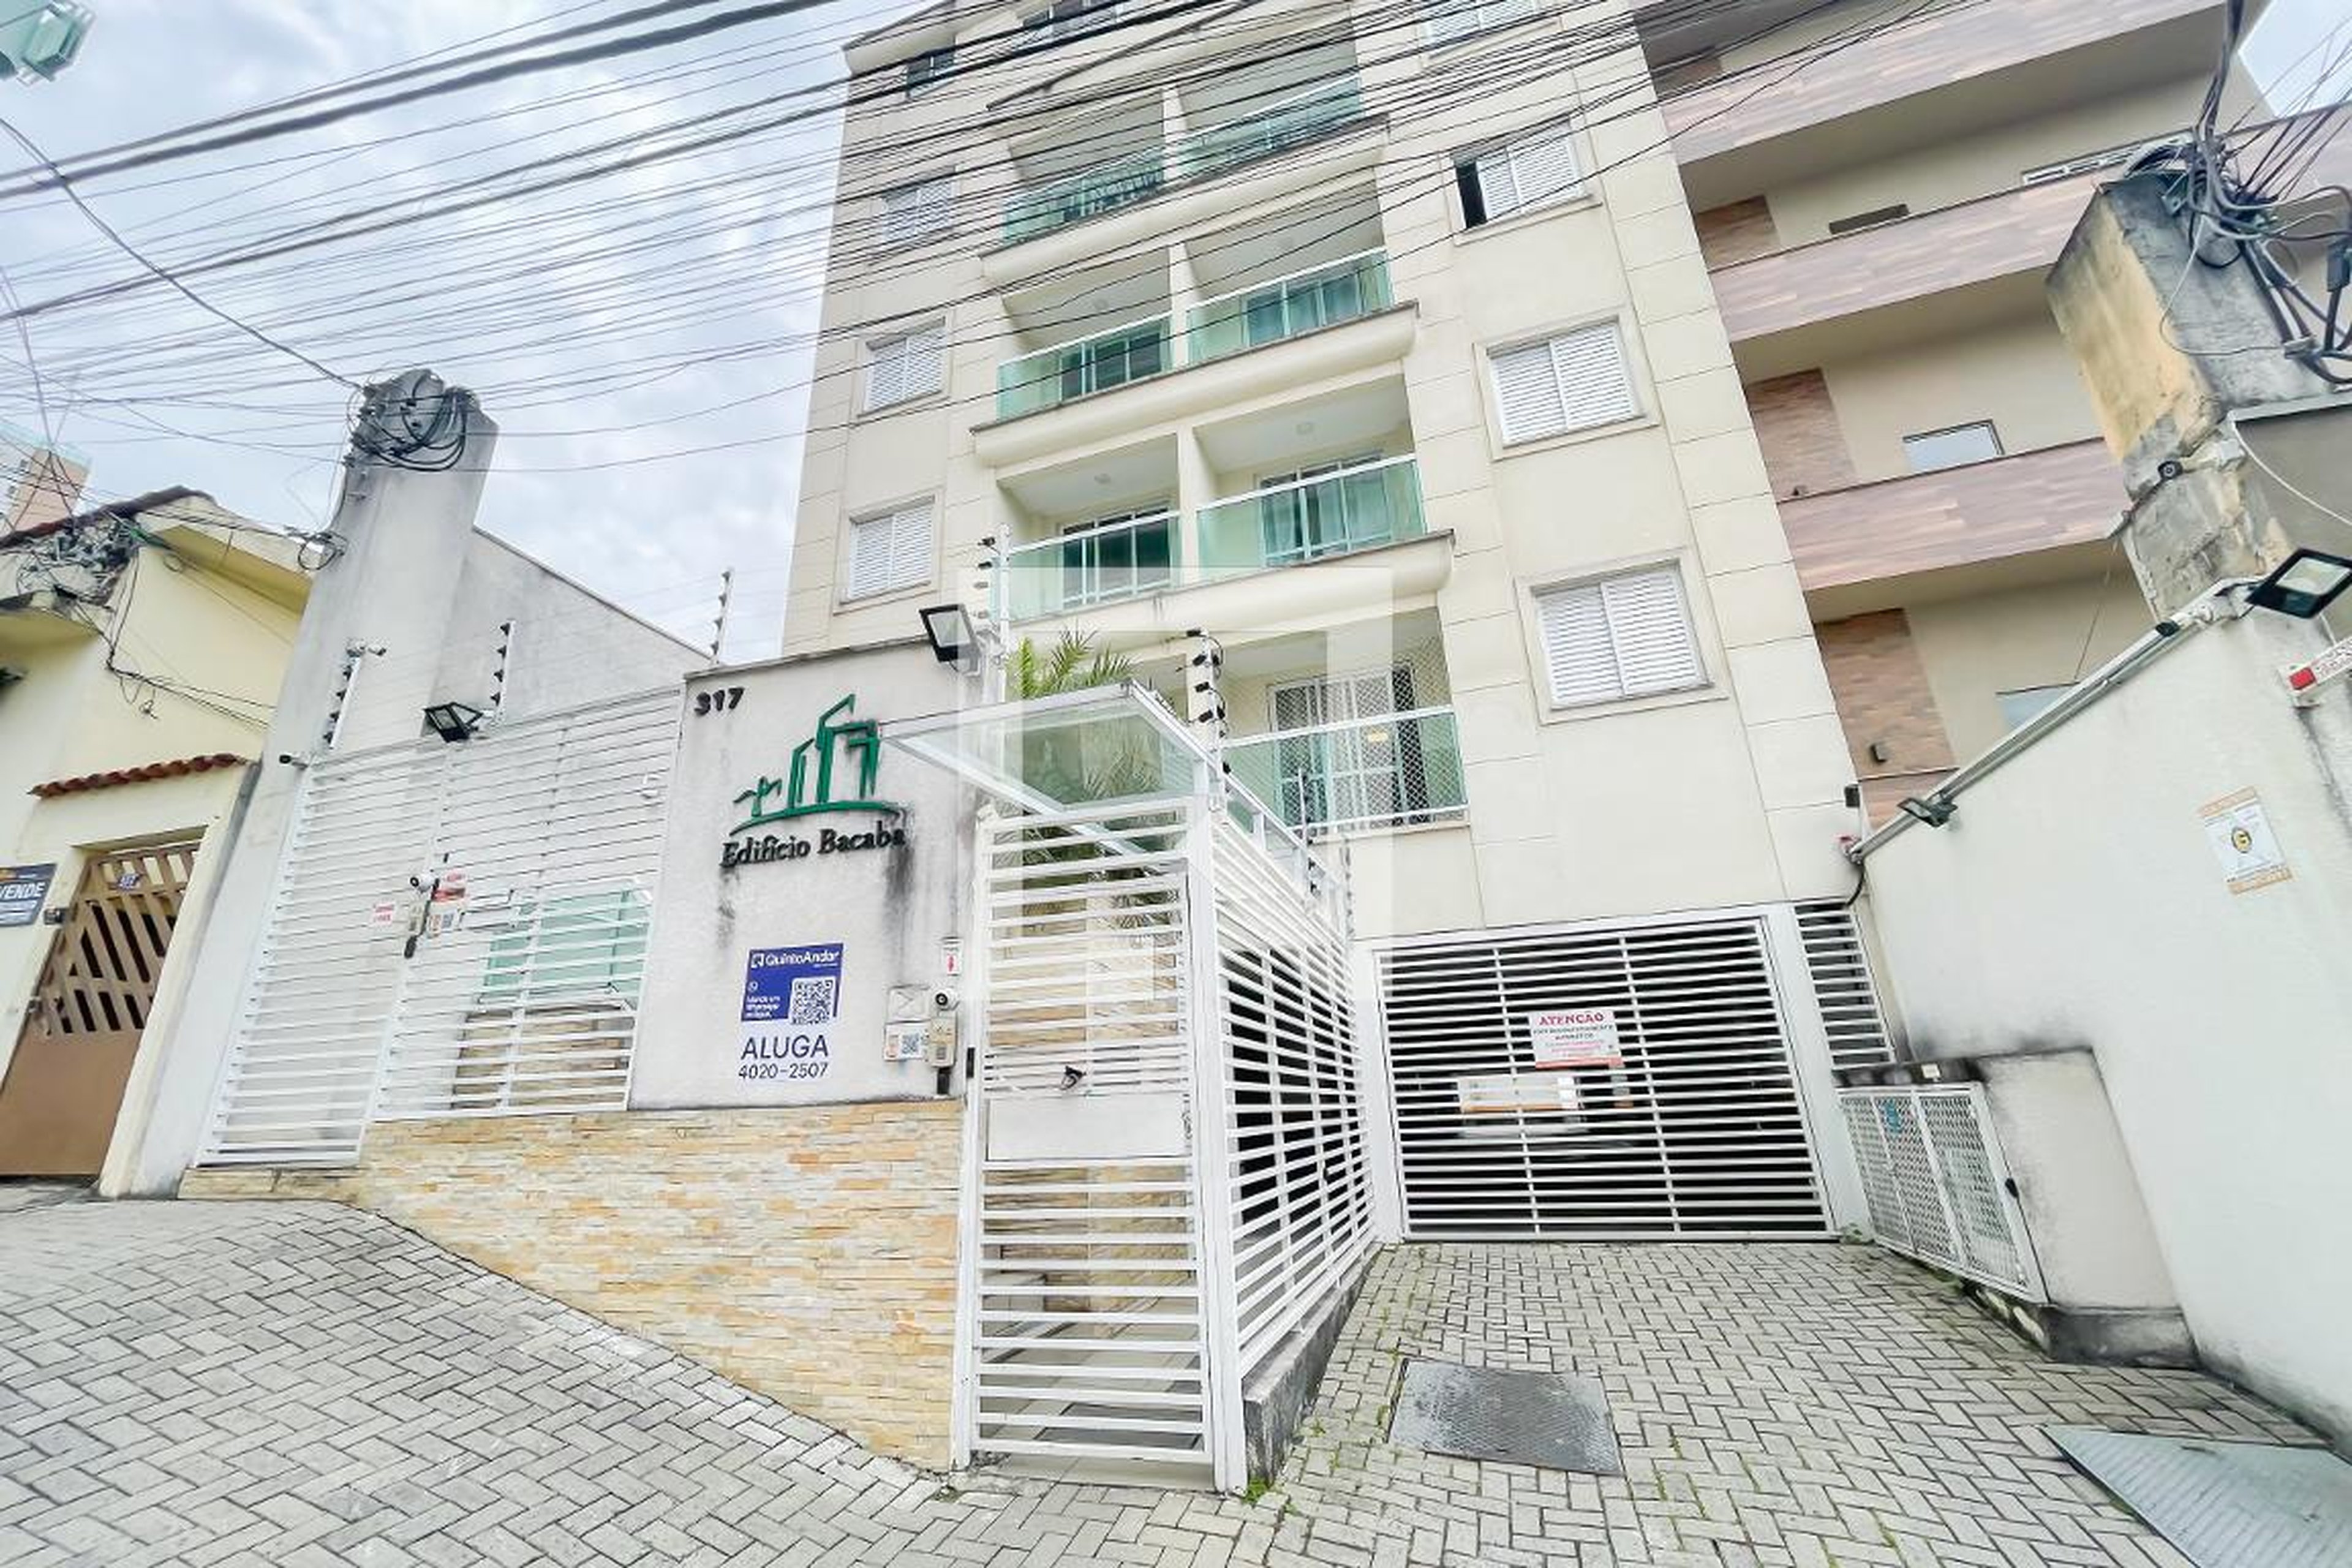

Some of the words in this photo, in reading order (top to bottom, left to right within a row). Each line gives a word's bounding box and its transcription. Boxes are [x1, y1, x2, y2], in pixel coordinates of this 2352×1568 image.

[694, 687, 744, 716] 317
[817, 820, 905, 854] Bacaba
[741, 1035, 829, 1060] ALUGA
[739, 1062, 829, 1079] 4020-2507
